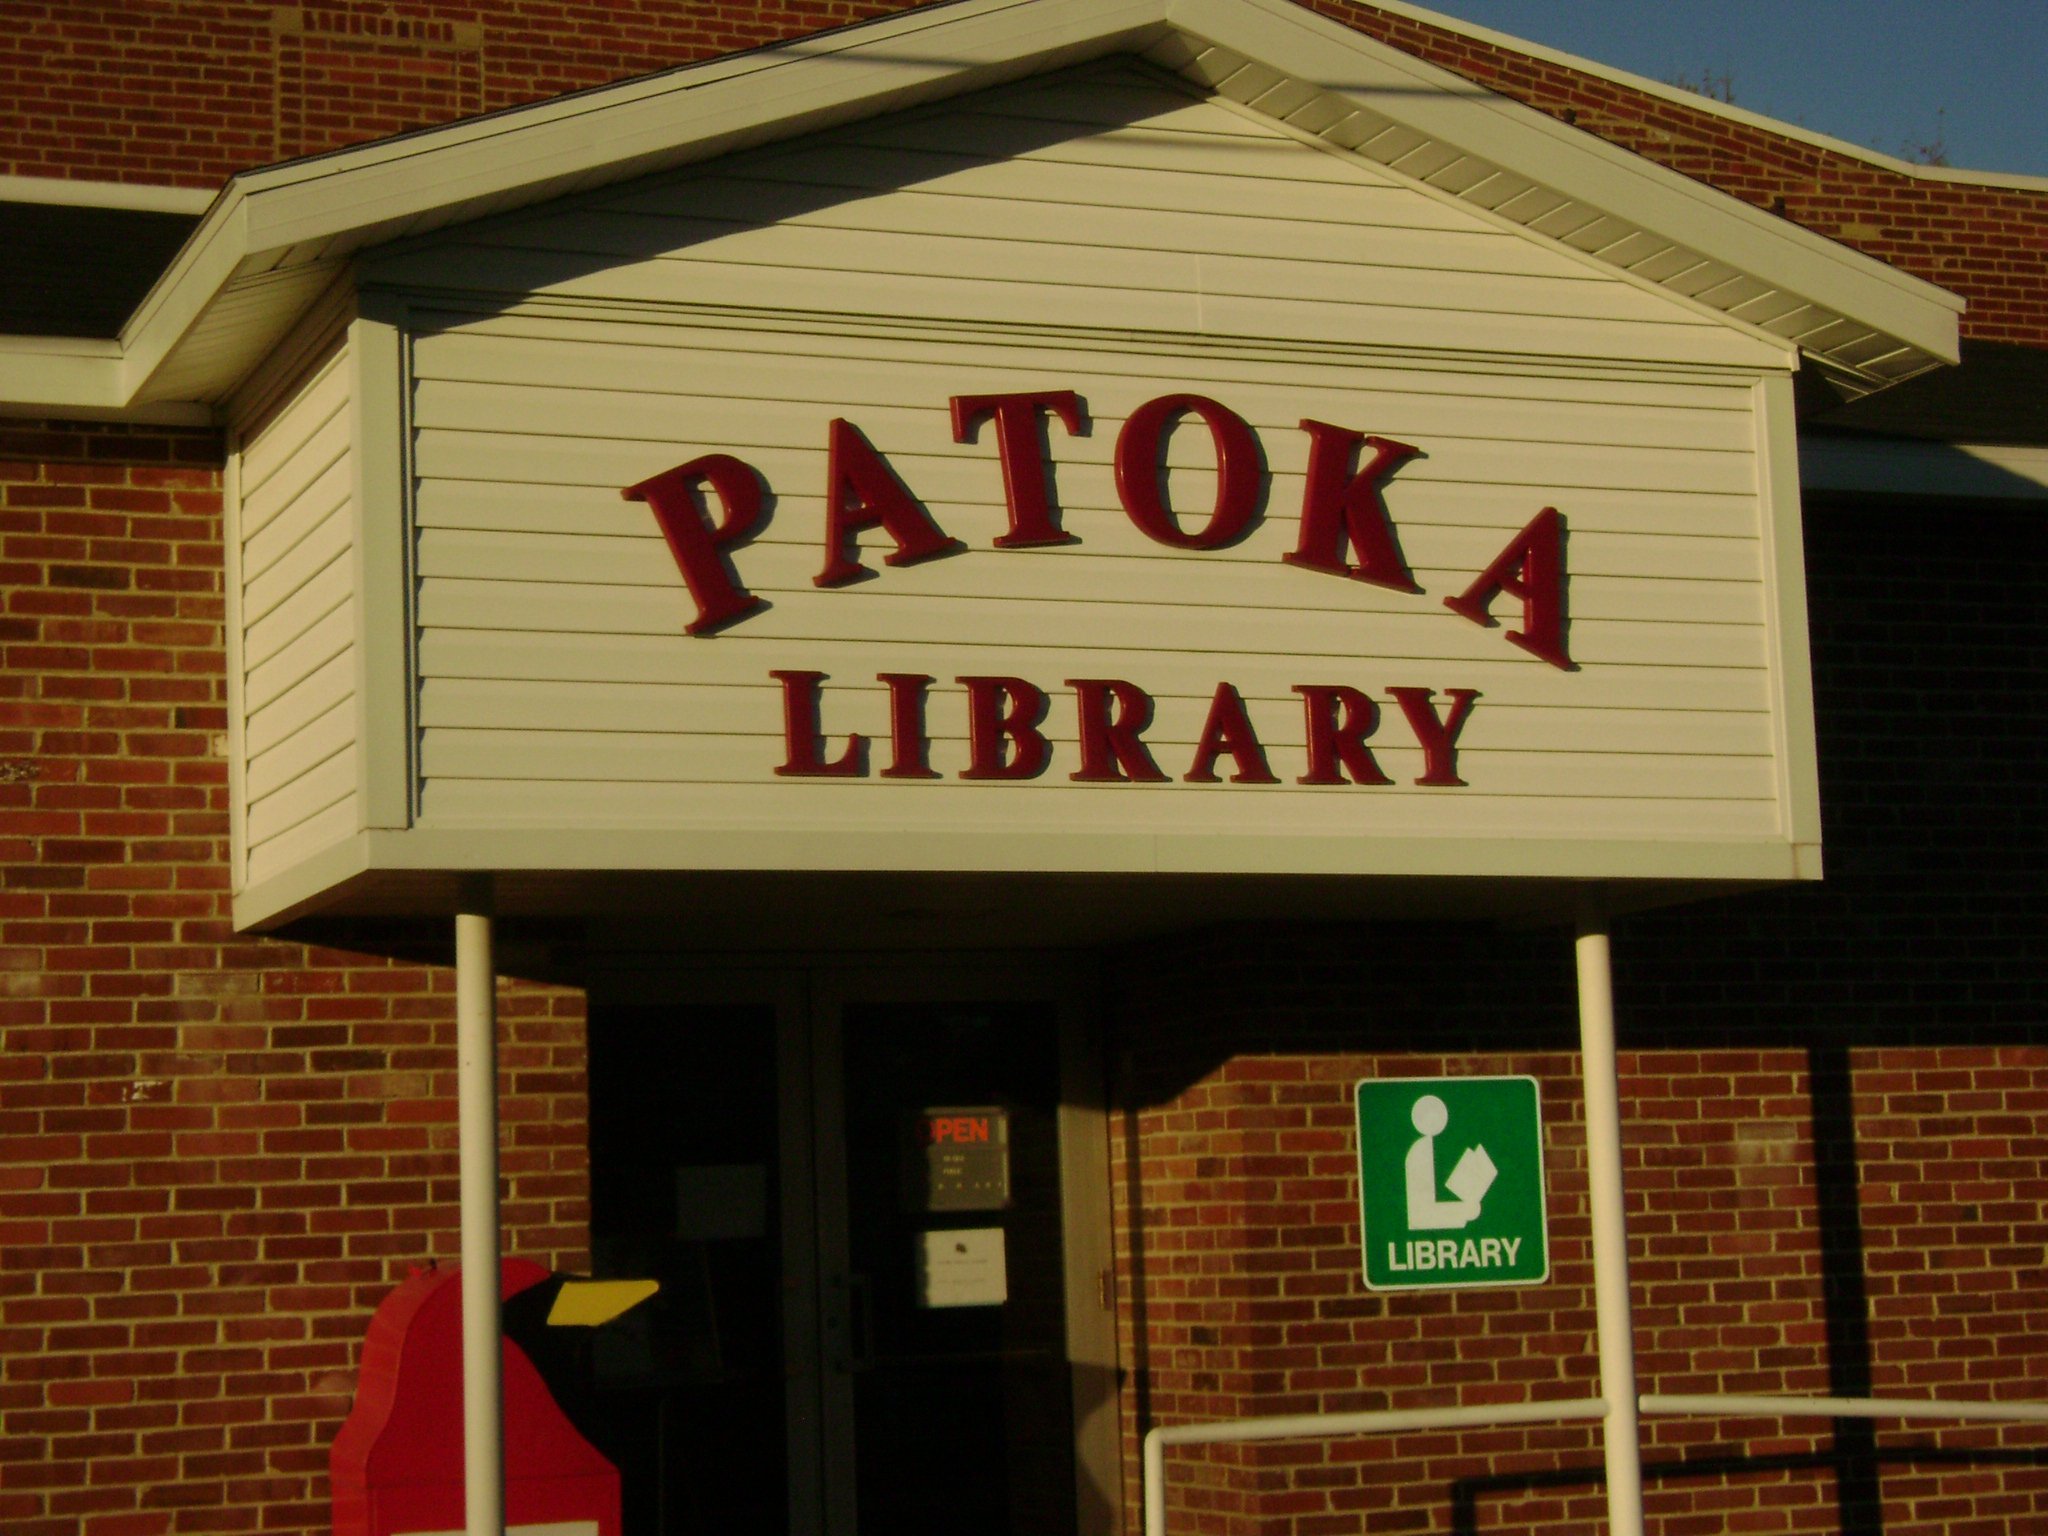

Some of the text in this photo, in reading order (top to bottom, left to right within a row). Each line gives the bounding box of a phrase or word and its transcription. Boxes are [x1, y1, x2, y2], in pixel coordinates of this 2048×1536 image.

[621, 391, 1579, 671] PATOKA
[769, 669, 1482, 787] LIBRARY
[1388, 1237, 1522, 1271] LIBRARY
